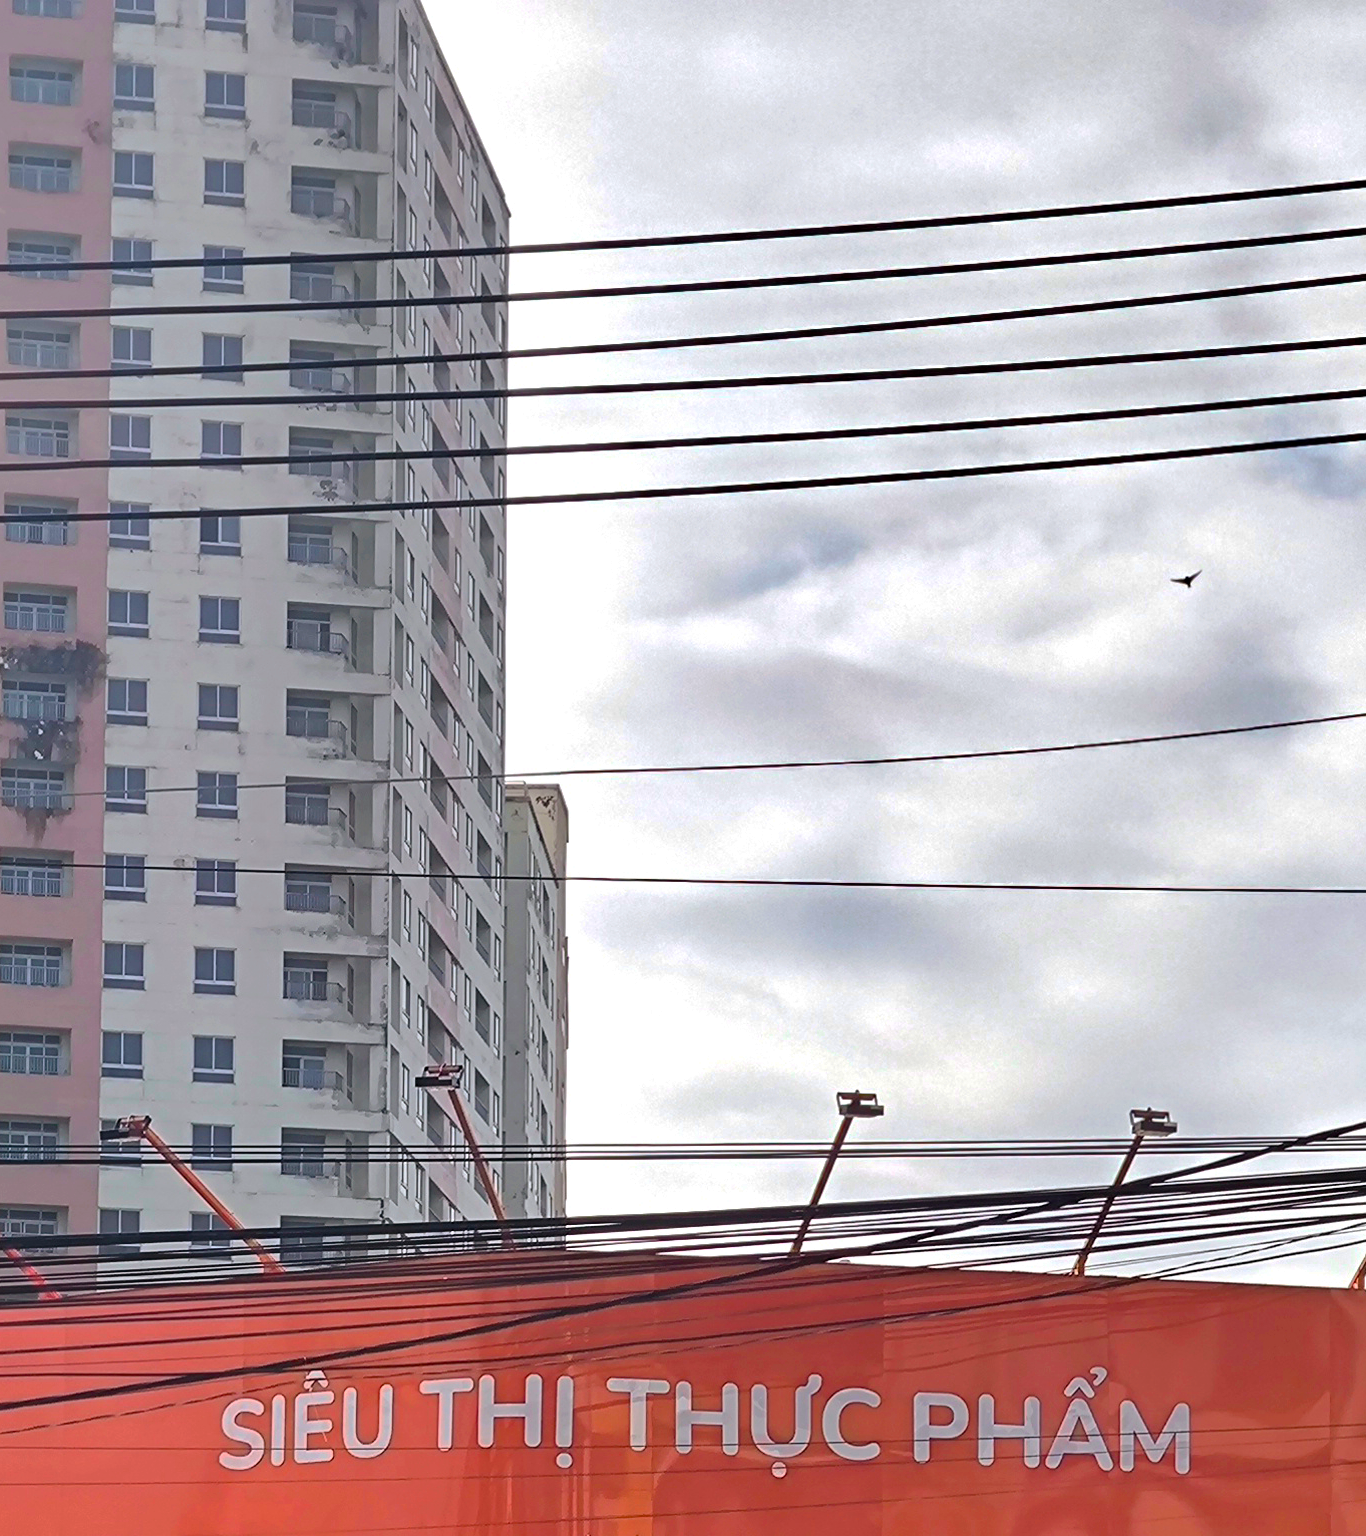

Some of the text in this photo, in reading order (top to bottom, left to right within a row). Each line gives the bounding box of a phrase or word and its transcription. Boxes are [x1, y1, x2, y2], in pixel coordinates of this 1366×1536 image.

[218, 1365, 1192, 1479] SIÊU THỊ THỰC PHẨM
